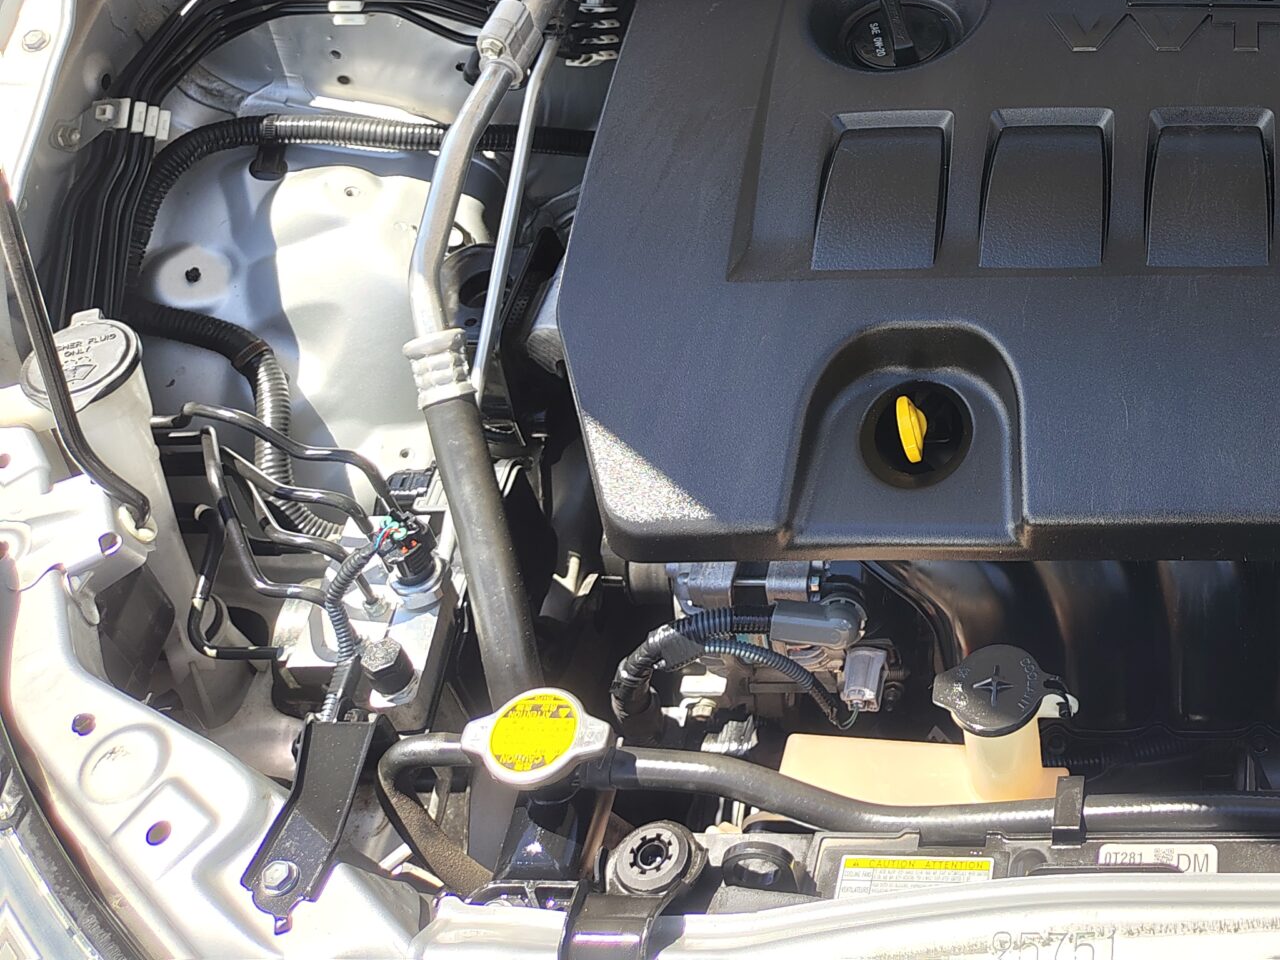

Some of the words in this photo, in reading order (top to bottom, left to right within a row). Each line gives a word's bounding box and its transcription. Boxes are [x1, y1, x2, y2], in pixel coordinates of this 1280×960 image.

[869, 22, 881, 35] SAE
[87, 333, 117, 344] FLUID
[64, 346, 92, 358] ONLY
[500, 754, 543, 764] CAUTION
[868, 860, 915, 868] CAUTION
[925, 860, 984, 869] ATTENTION
[1177, 853, 1209, 873] DM
